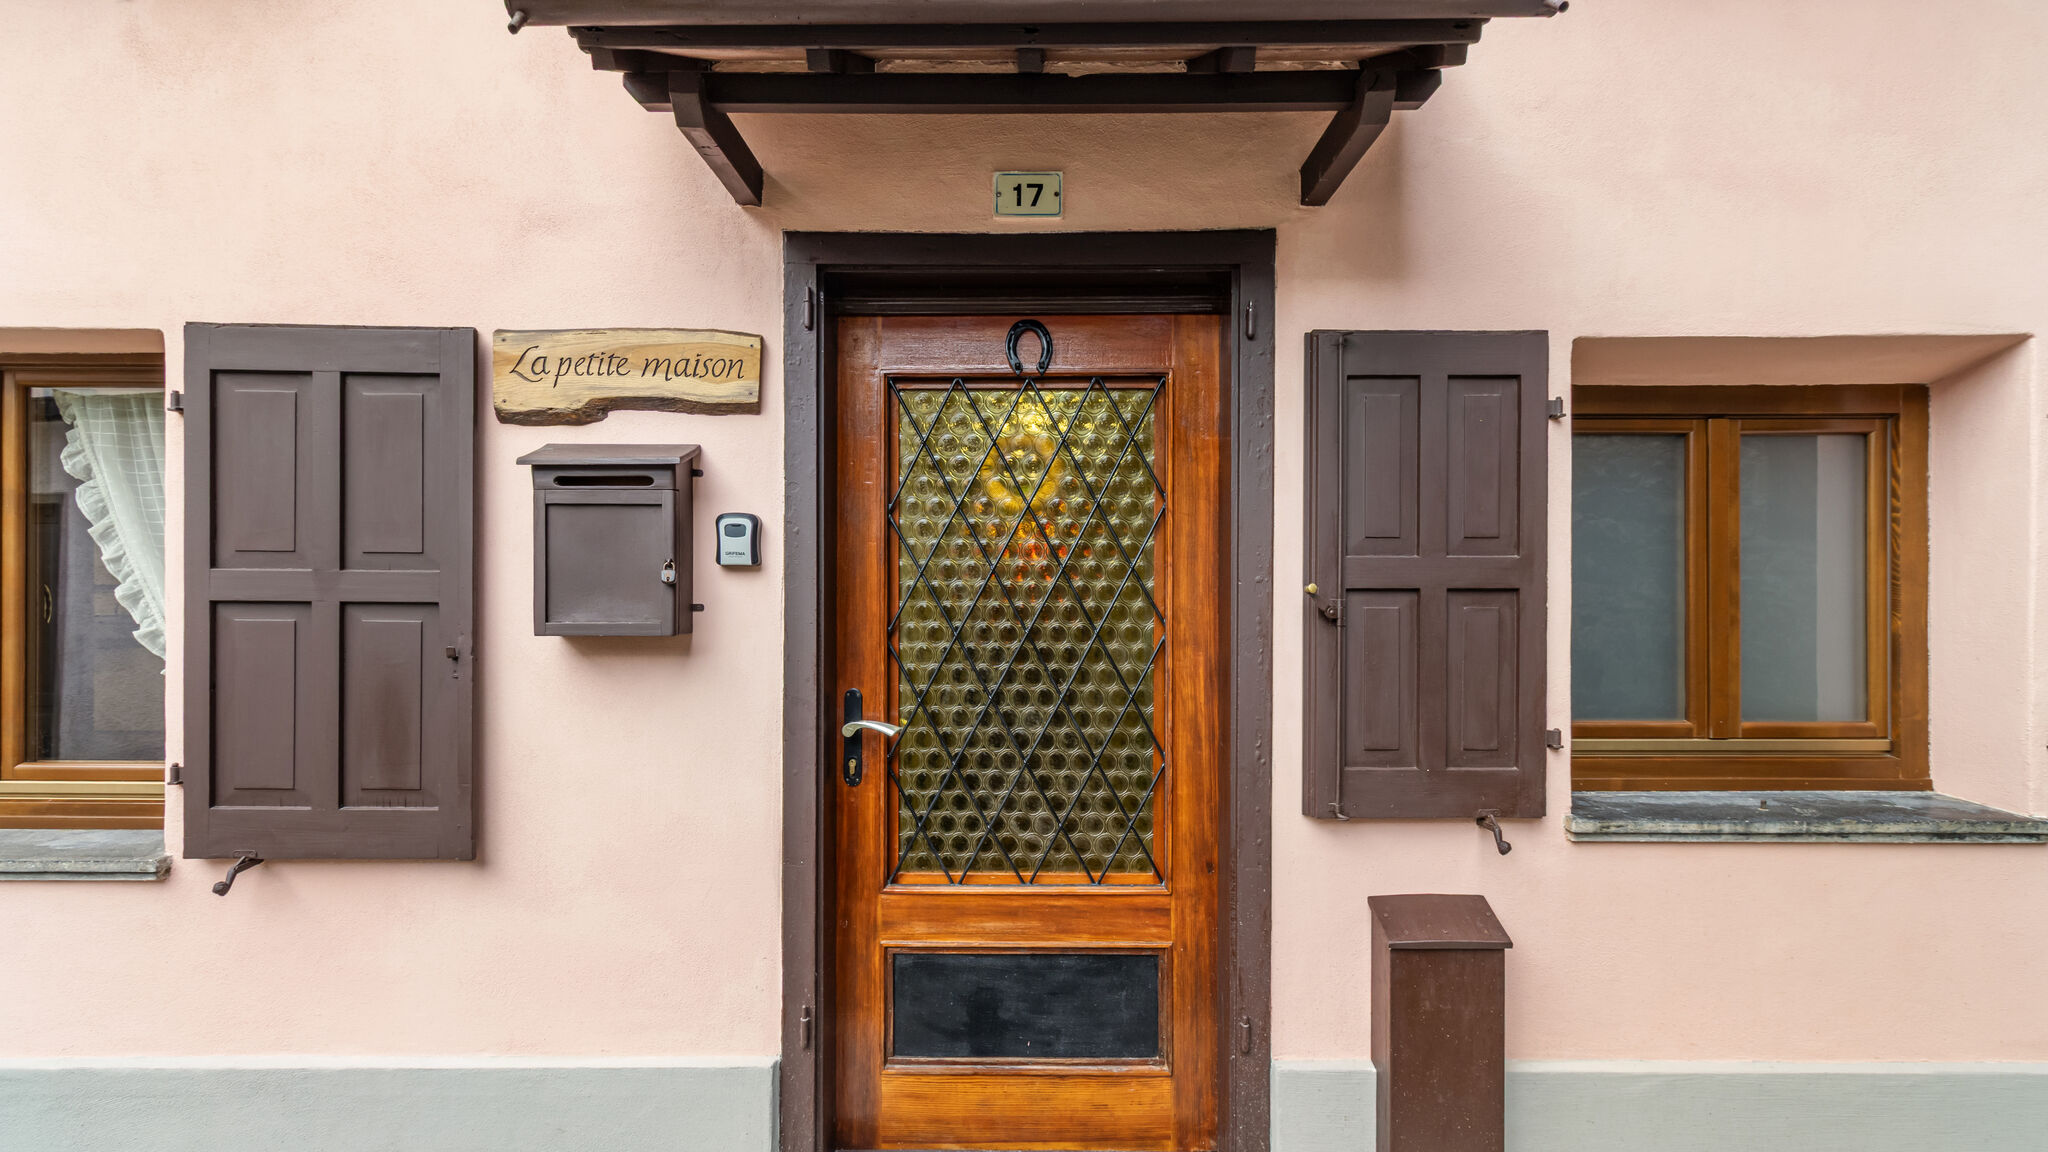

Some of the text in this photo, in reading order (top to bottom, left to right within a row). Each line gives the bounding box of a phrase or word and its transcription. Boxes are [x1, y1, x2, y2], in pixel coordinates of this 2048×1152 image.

[1012, 183, 1044, 207] 17
[508, 345, 745, 388] La petite maison
